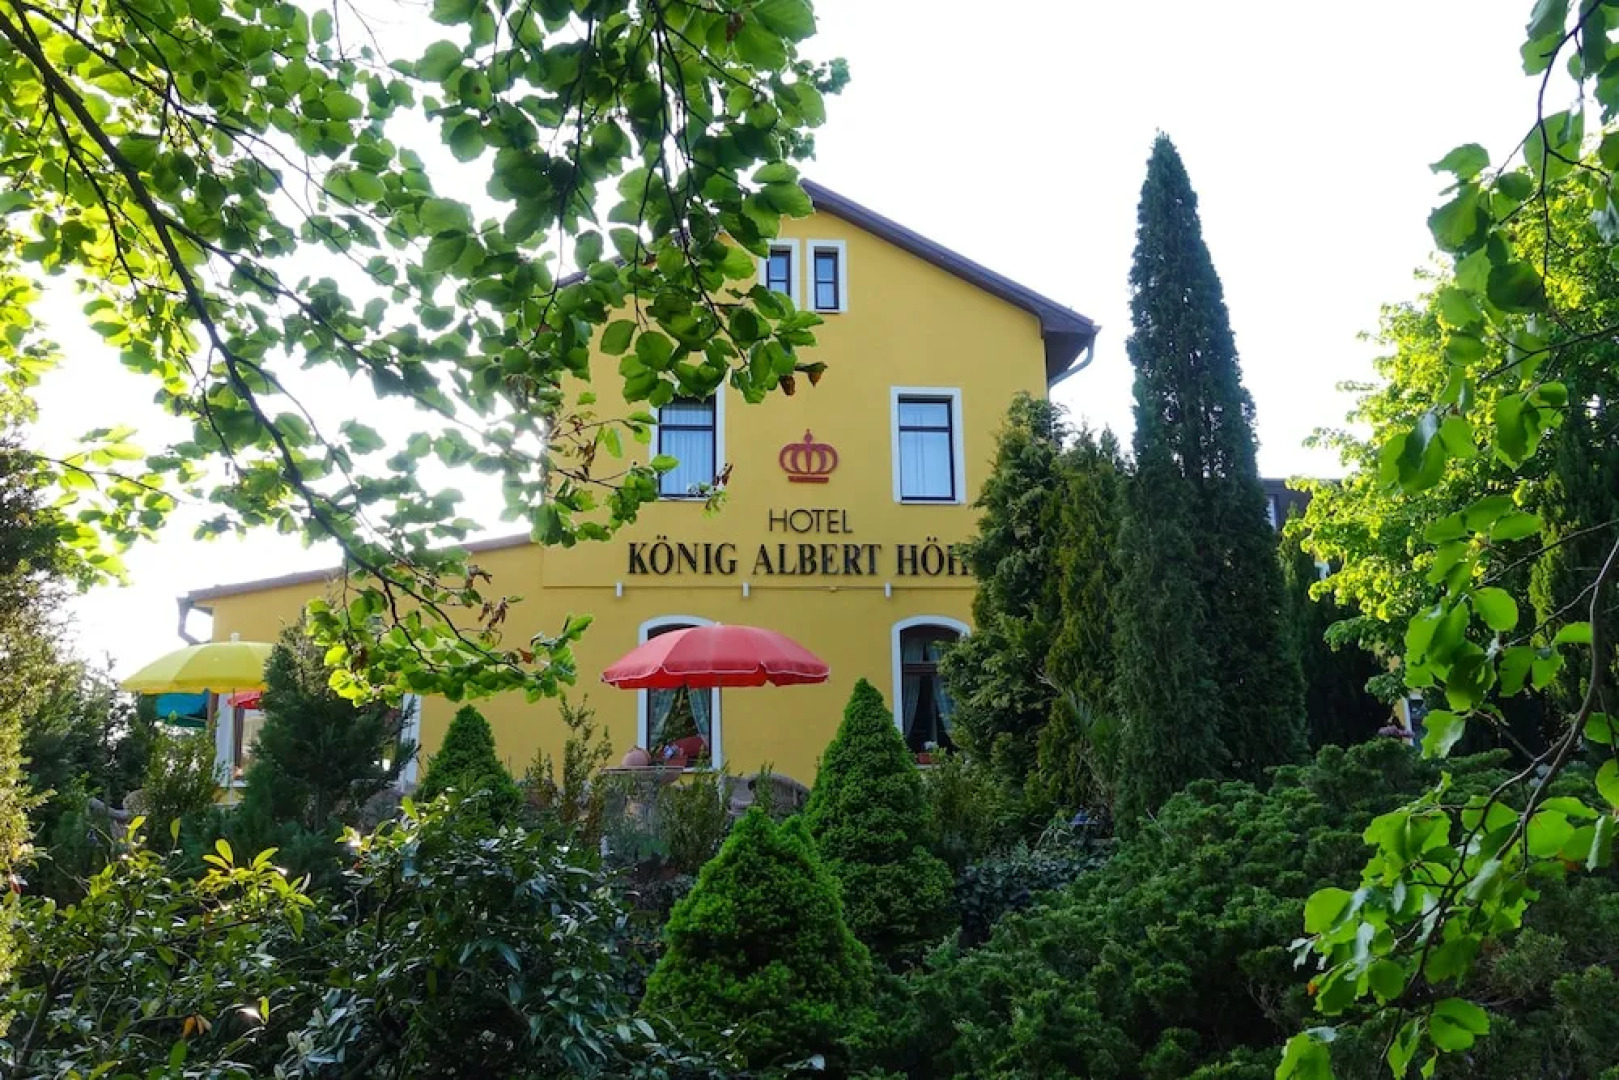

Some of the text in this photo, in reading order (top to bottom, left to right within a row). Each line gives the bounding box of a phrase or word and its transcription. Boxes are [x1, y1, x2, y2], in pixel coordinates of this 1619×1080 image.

[769, 508, 853, 533] HOTEL
[628, 534, 738, 575] KÖNIG
[752, 543, 882, 576] ALBERT
